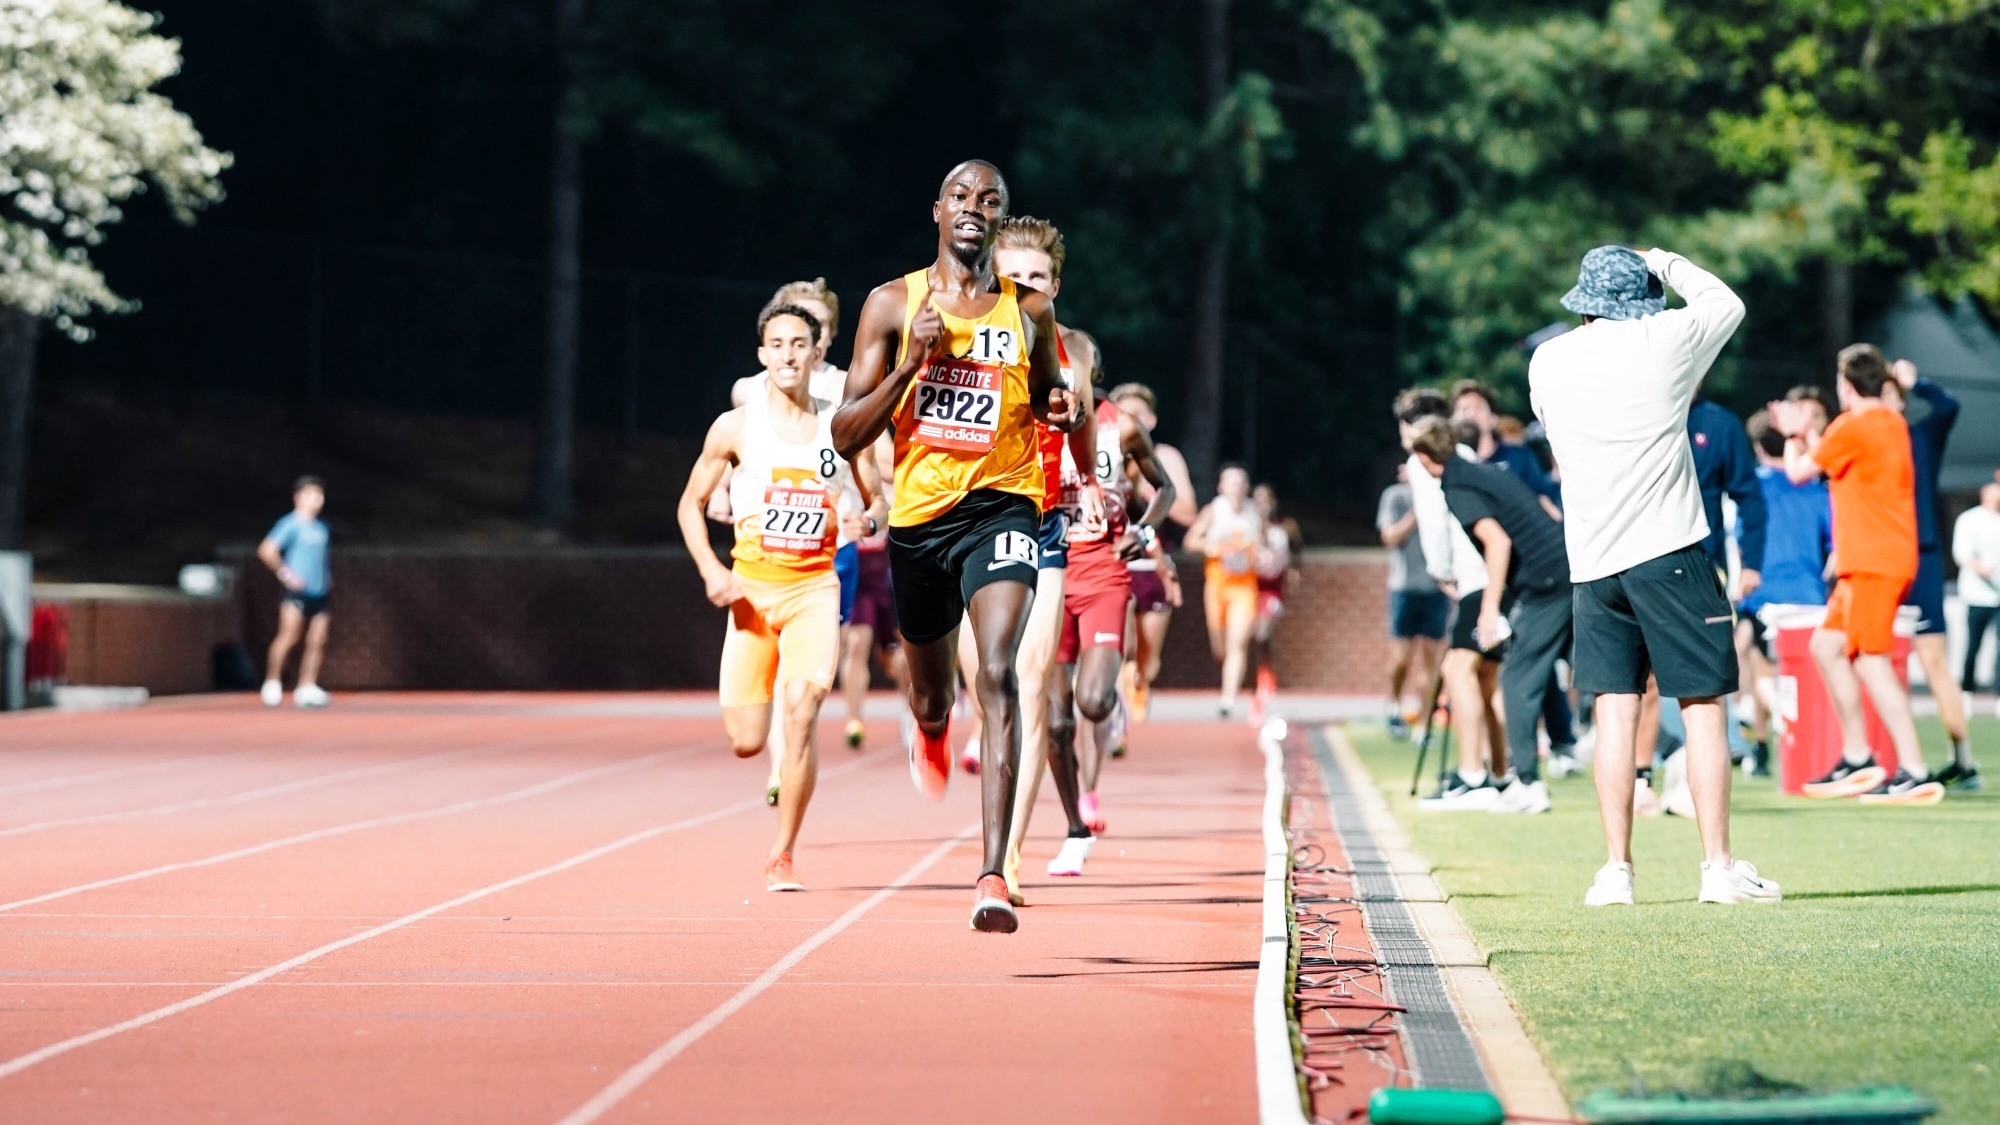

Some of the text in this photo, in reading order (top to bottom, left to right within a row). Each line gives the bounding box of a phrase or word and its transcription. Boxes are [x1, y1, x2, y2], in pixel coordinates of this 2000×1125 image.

[979, 328, 1012, 360] 13
[926, 365, 947, 381] NC
[949, 368, 993, 389] STATE
[918, 385, 994, 425] 2922
[944, 428, 991, 444] adidas
[820, 448, 836, 478] 8
[770, 490, 824, 508] NC STATE
[765, 508, 824, 535] 2727
[786, 539, 821, 550] adidas
[1002, 531, 1033, 561] 13
